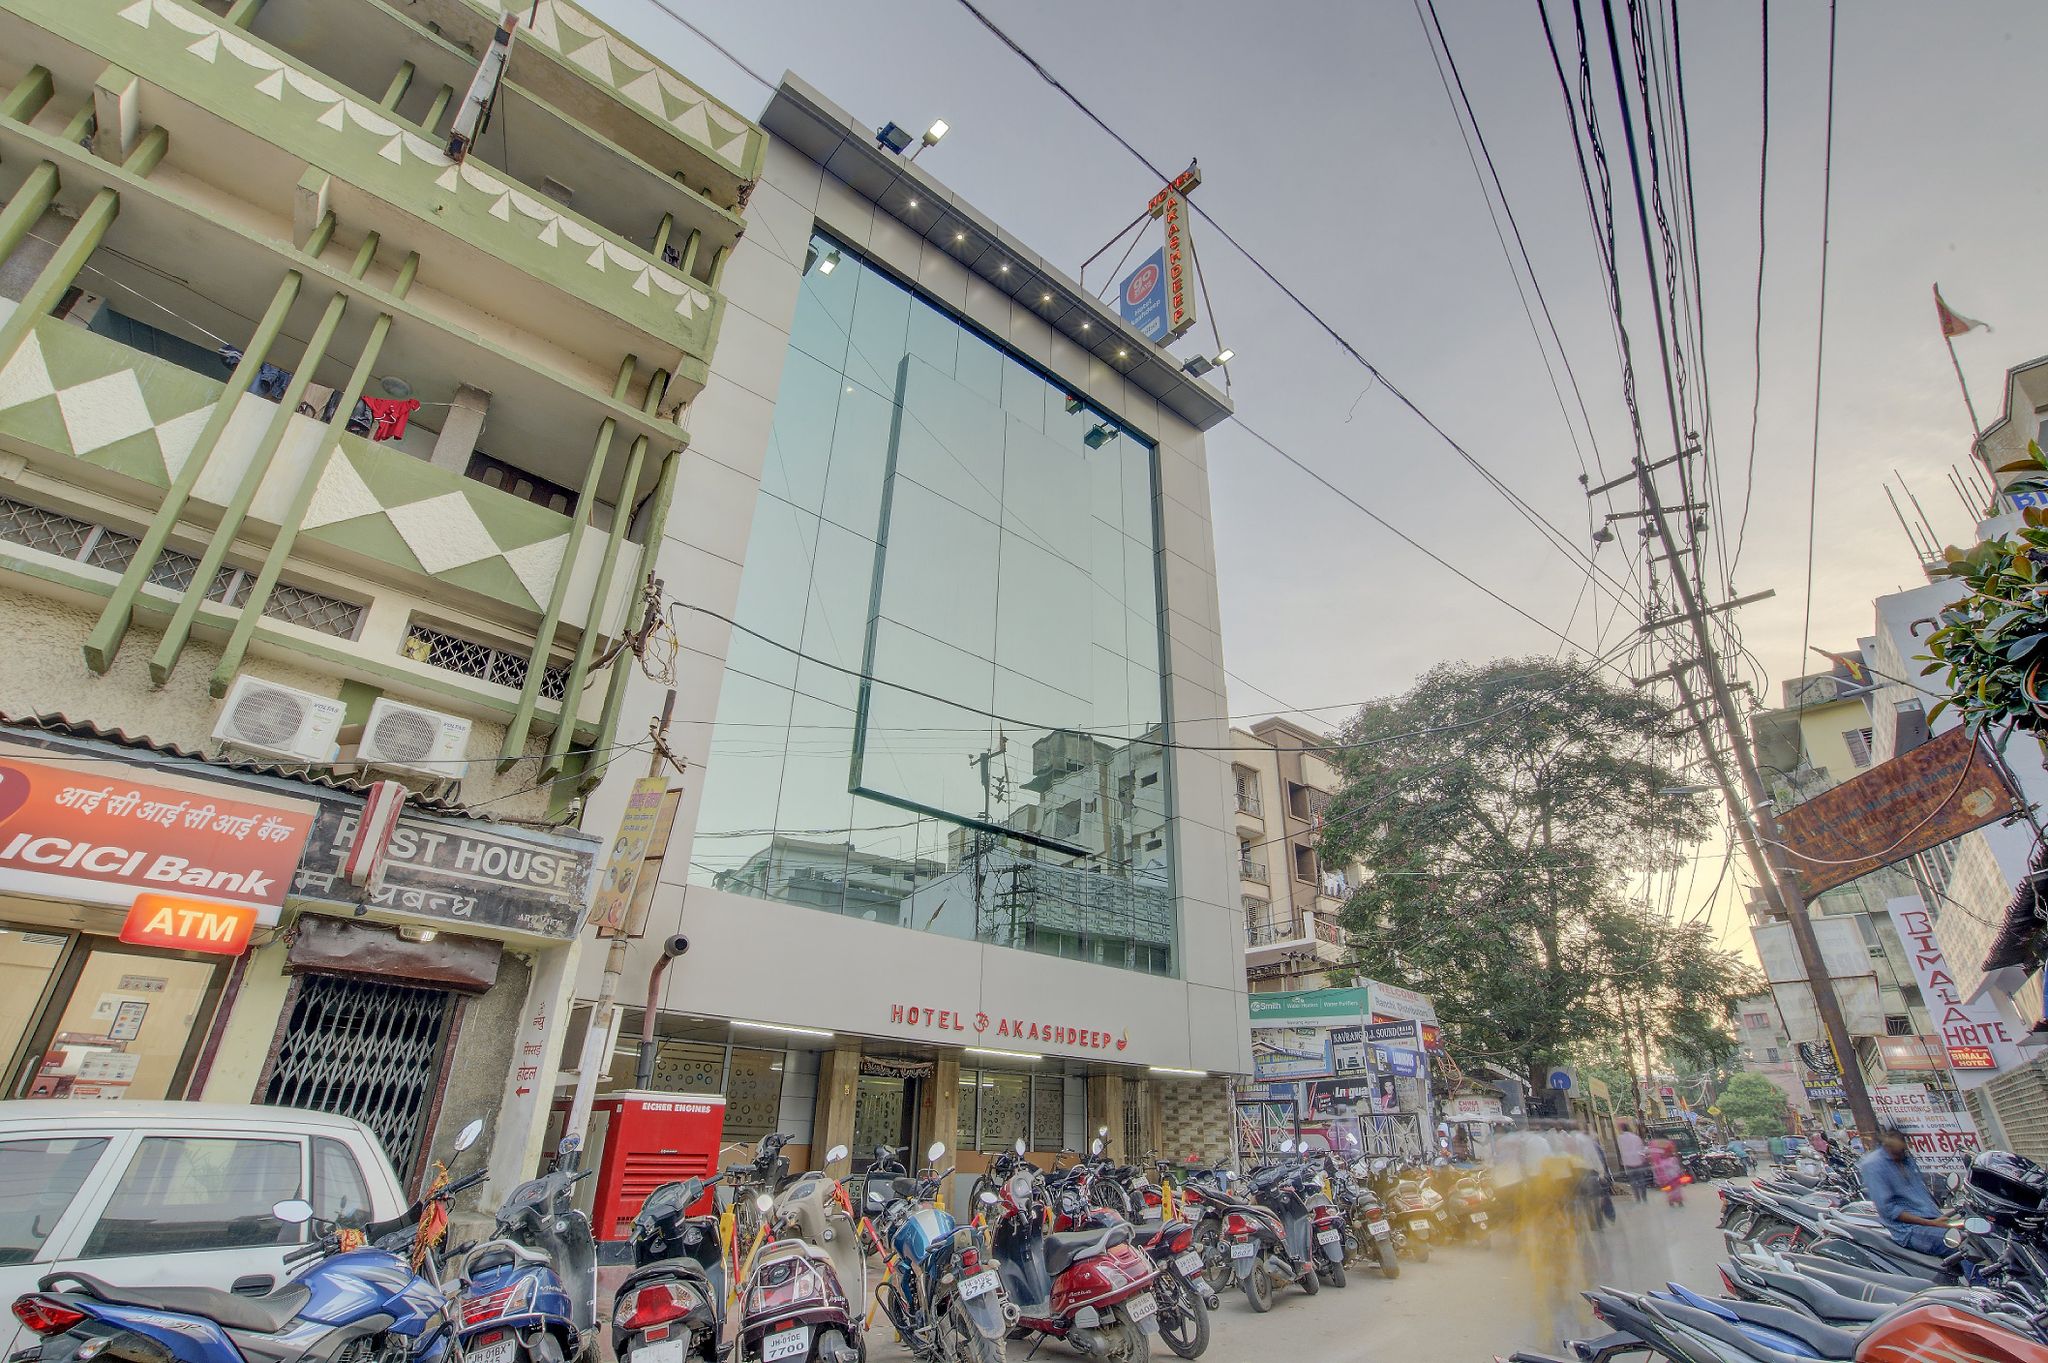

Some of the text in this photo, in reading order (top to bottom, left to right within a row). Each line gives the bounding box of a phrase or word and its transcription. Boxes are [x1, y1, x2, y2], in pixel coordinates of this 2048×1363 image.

[1166, 197, 1185, 325] AKASHDEEP
[313, 702, 339, 714] VOLTAS
[442, 722, 467, 732] VOLTAS
[256, 816, 296, 843] बैंक
[0, 833, 149, 877] ICICI
[143, 855, 277, 897] Bank
[454, 839, 577, 887] HOUSE
[142, 907, 239, 943] ATM
[1900, 911, 1972, 1025] BIMALA
[1377, 983, 1420, 1001] WELCOME
[890, 1004, 964, 1032] HOTEL
[996, 1018, 1111, 1049] AKASHDEEP
[1951, 1051, 1991, 1061] BIMALA
[642, 1102, 711, 1114] EICHER ENGINES
[1904, 1129, 1981, 1153] मला होटल
[1132, 1303, 1157, 1320] 0408
[769, 1342, 805, 1358] 7700
